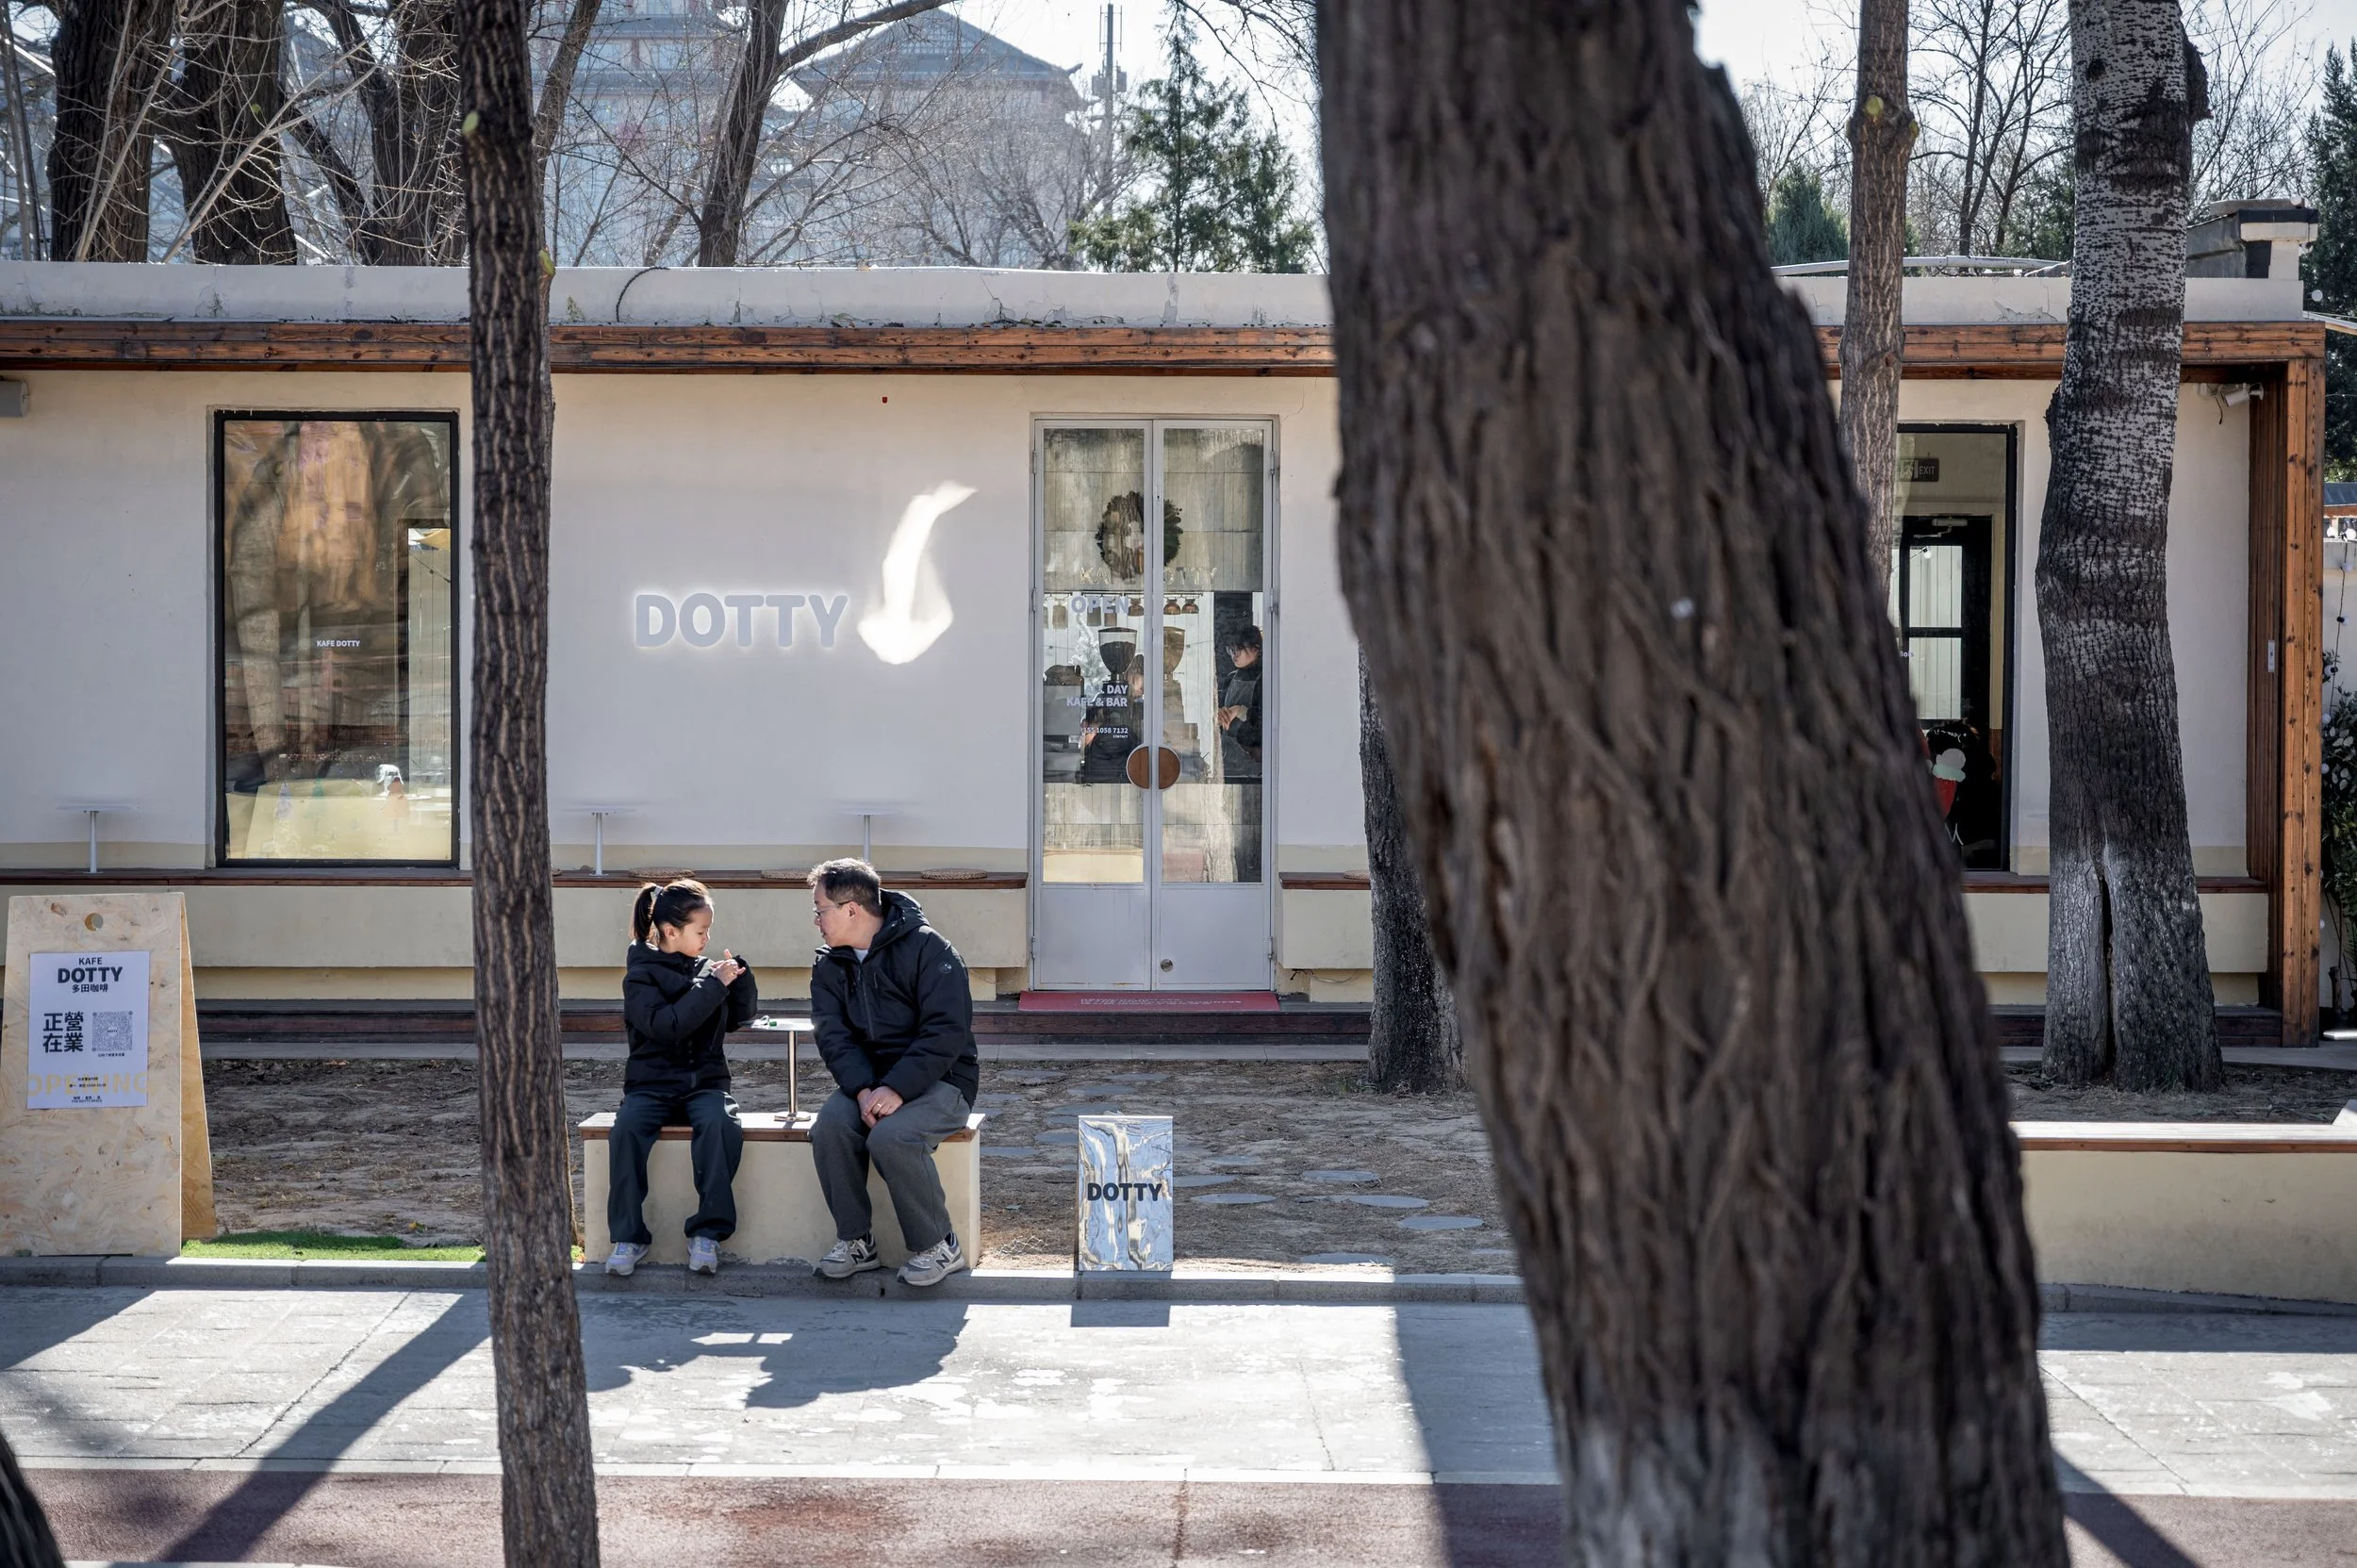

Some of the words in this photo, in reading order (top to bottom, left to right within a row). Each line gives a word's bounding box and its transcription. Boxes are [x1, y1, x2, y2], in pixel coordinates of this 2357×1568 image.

[1919, 466, 1936, 475] EXIT
[1162, 566, 1218, 586] OTTY
[1071, 595, 1129, 614] OPEN
[635, 592, 849, 648] DOTTY
[316, 639, 336, 648] KAFE
[336, 639, 360, 648] DOTTY
[1107, 685, 1129, 695] DAY
[1066, 697, 1094, 707] KAFE
[1095, 697, 1105, 707] &
[1106, 697, 1129, 707] BAR
[1113, 727, 1129, 735] 7132
[78, 956, 103, 966] KAFE
[58, 966, 124, 983] DOTTY
[72, 983, 108, 994] 多田咖啡
[27, 1071, 148, 1097] OPENING
[1087, 1182, 1162, 1201] DOTTY
